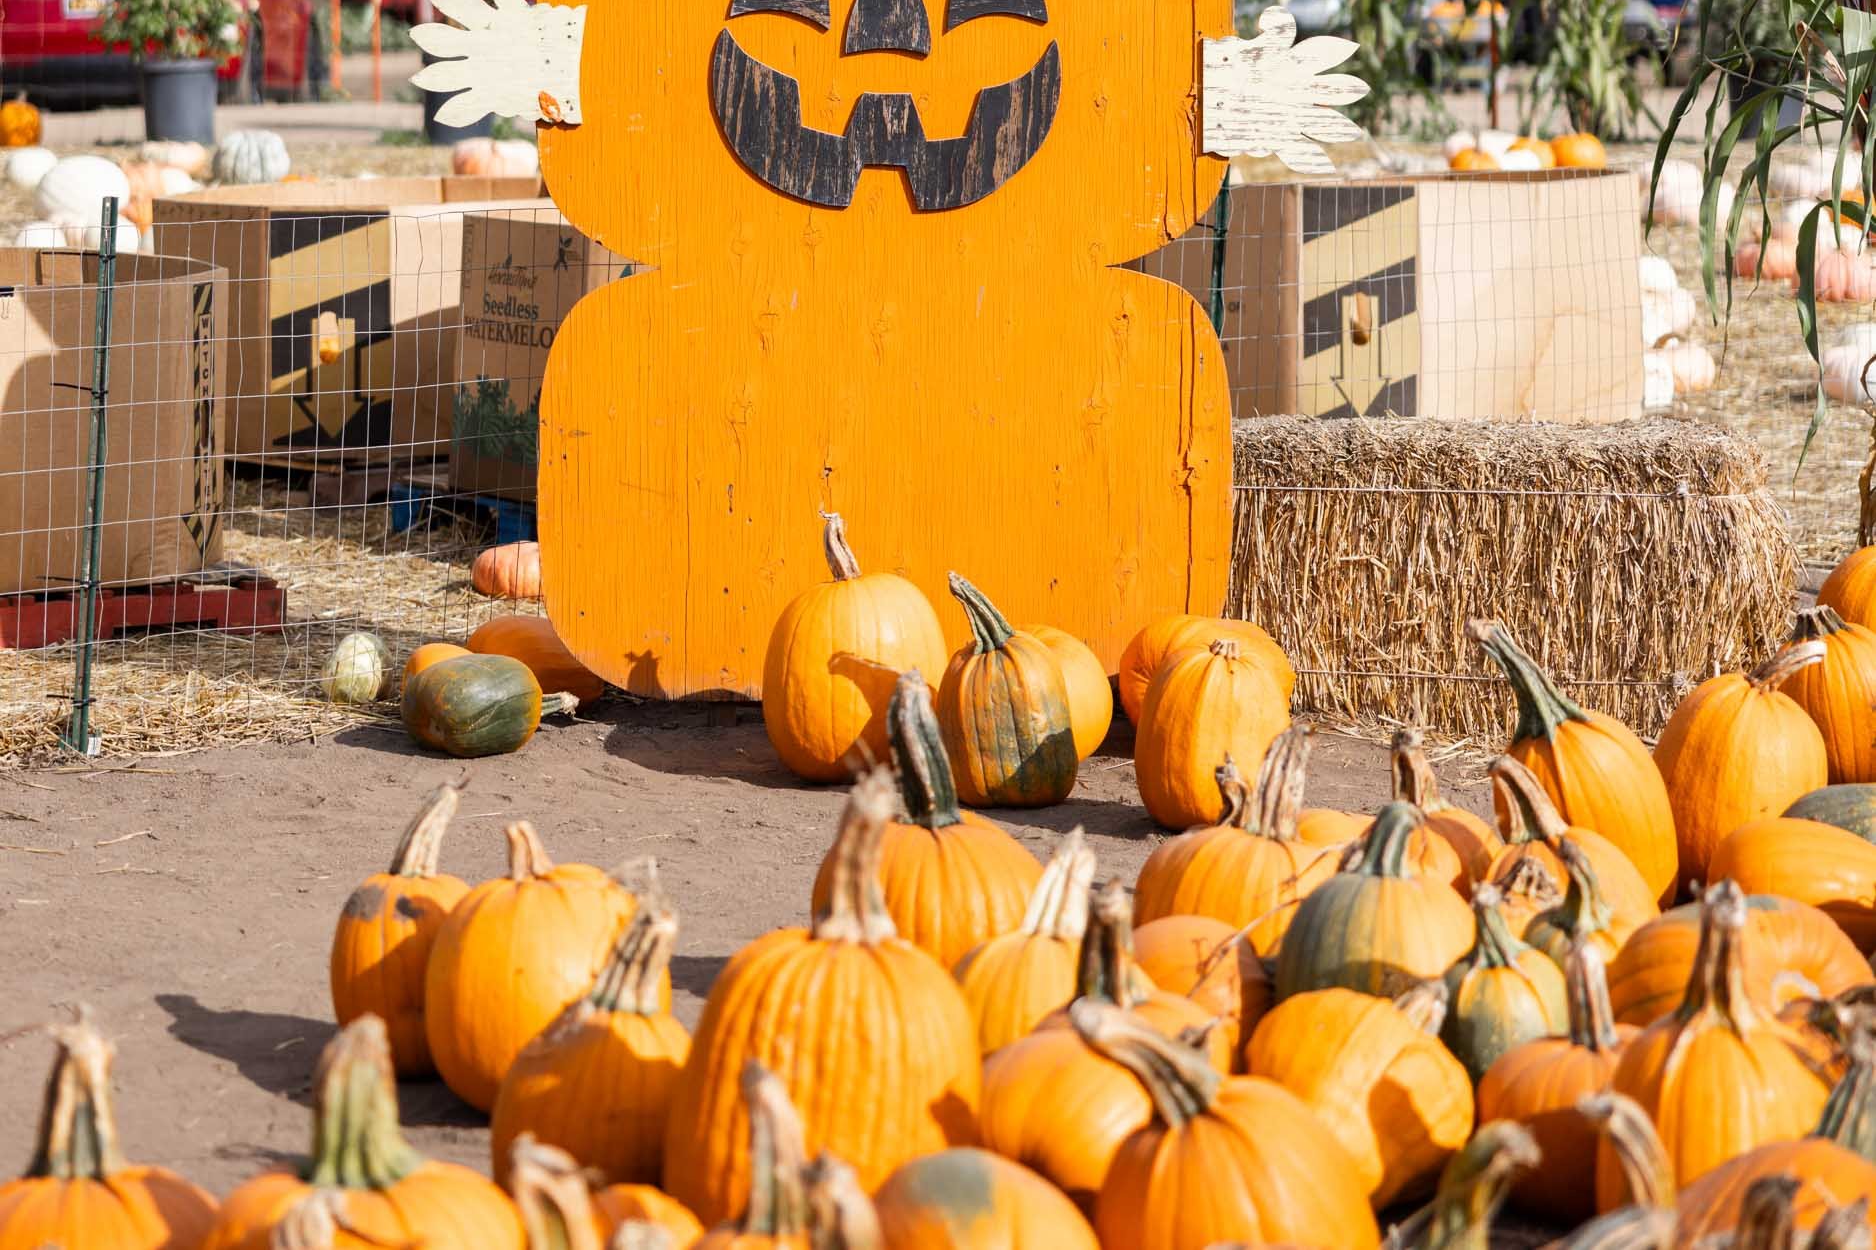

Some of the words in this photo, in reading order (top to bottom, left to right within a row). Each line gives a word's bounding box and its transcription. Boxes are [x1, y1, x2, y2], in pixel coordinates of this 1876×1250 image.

[483, 292, 540, 320] Seedless
[464, 316, 558, 350] WATERMELO
[201, 317, 209, 396] WATCH
